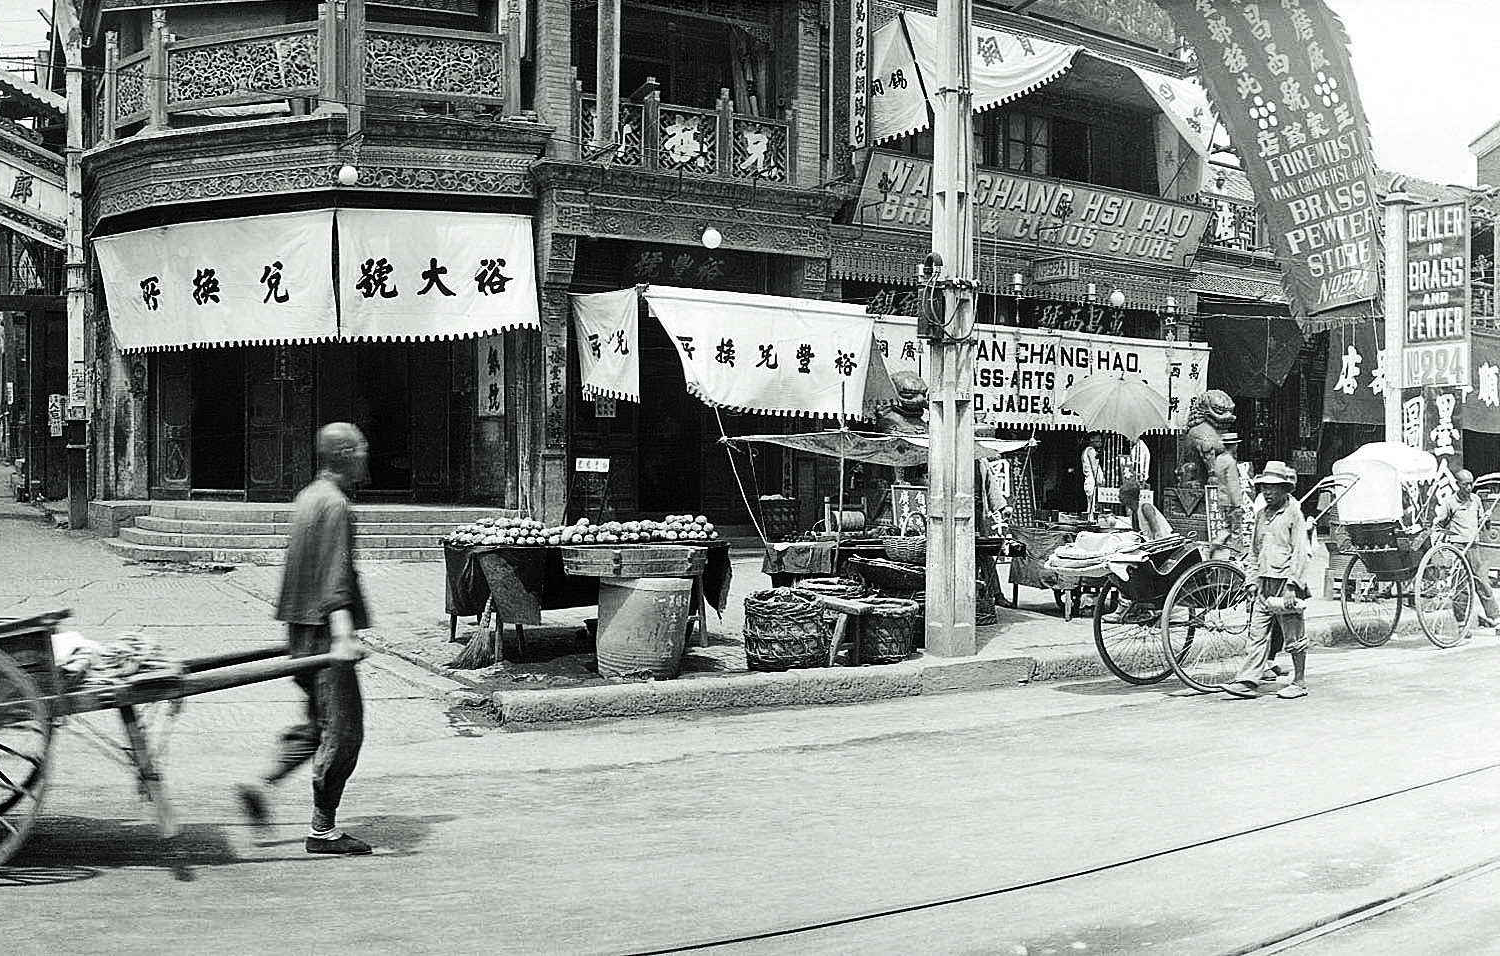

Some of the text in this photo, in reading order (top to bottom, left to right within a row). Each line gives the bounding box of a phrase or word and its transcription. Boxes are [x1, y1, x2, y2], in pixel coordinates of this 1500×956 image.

[887, 158, 932, 198] WA
[1081, 191, 1133, 228] HSI
[1137, 201, 1195, 239] HAO
[1287, 181, 1368, 226] BRASS
[1408, 206, 1463, 243] DEALER
[1408, 256, 1464, 292] BRASS
[1422, 291, 1449, 306] AND
[1408, 306, 1464, 340] PEWTER
